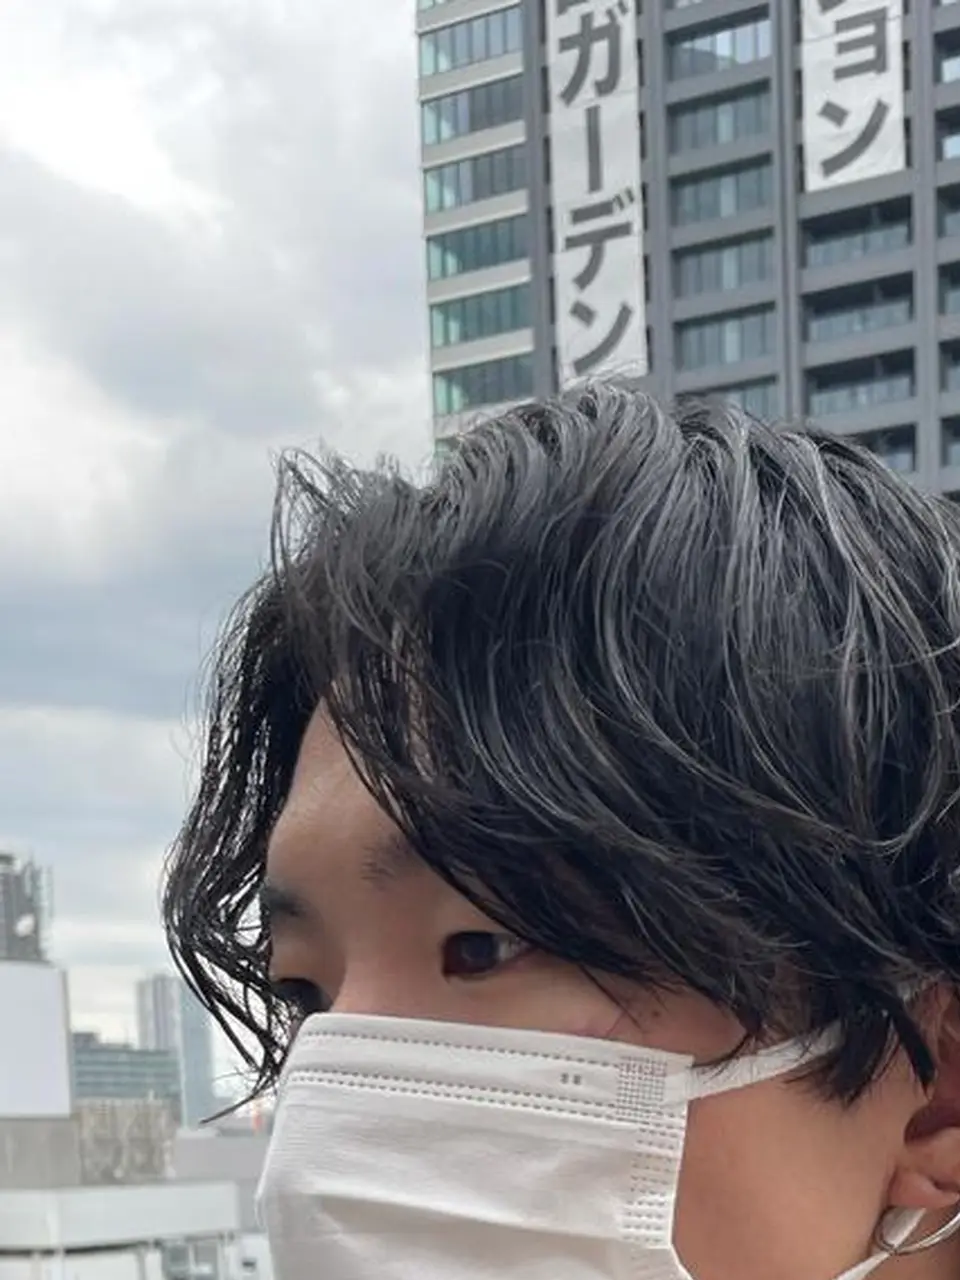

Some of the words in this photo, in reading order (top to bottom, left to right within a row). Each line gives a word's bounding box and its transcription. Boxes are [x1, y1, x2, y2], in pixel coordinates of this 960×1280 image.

[556, 0, 635, 376] ガーデン
[817, 0, 890, 180] ョン
